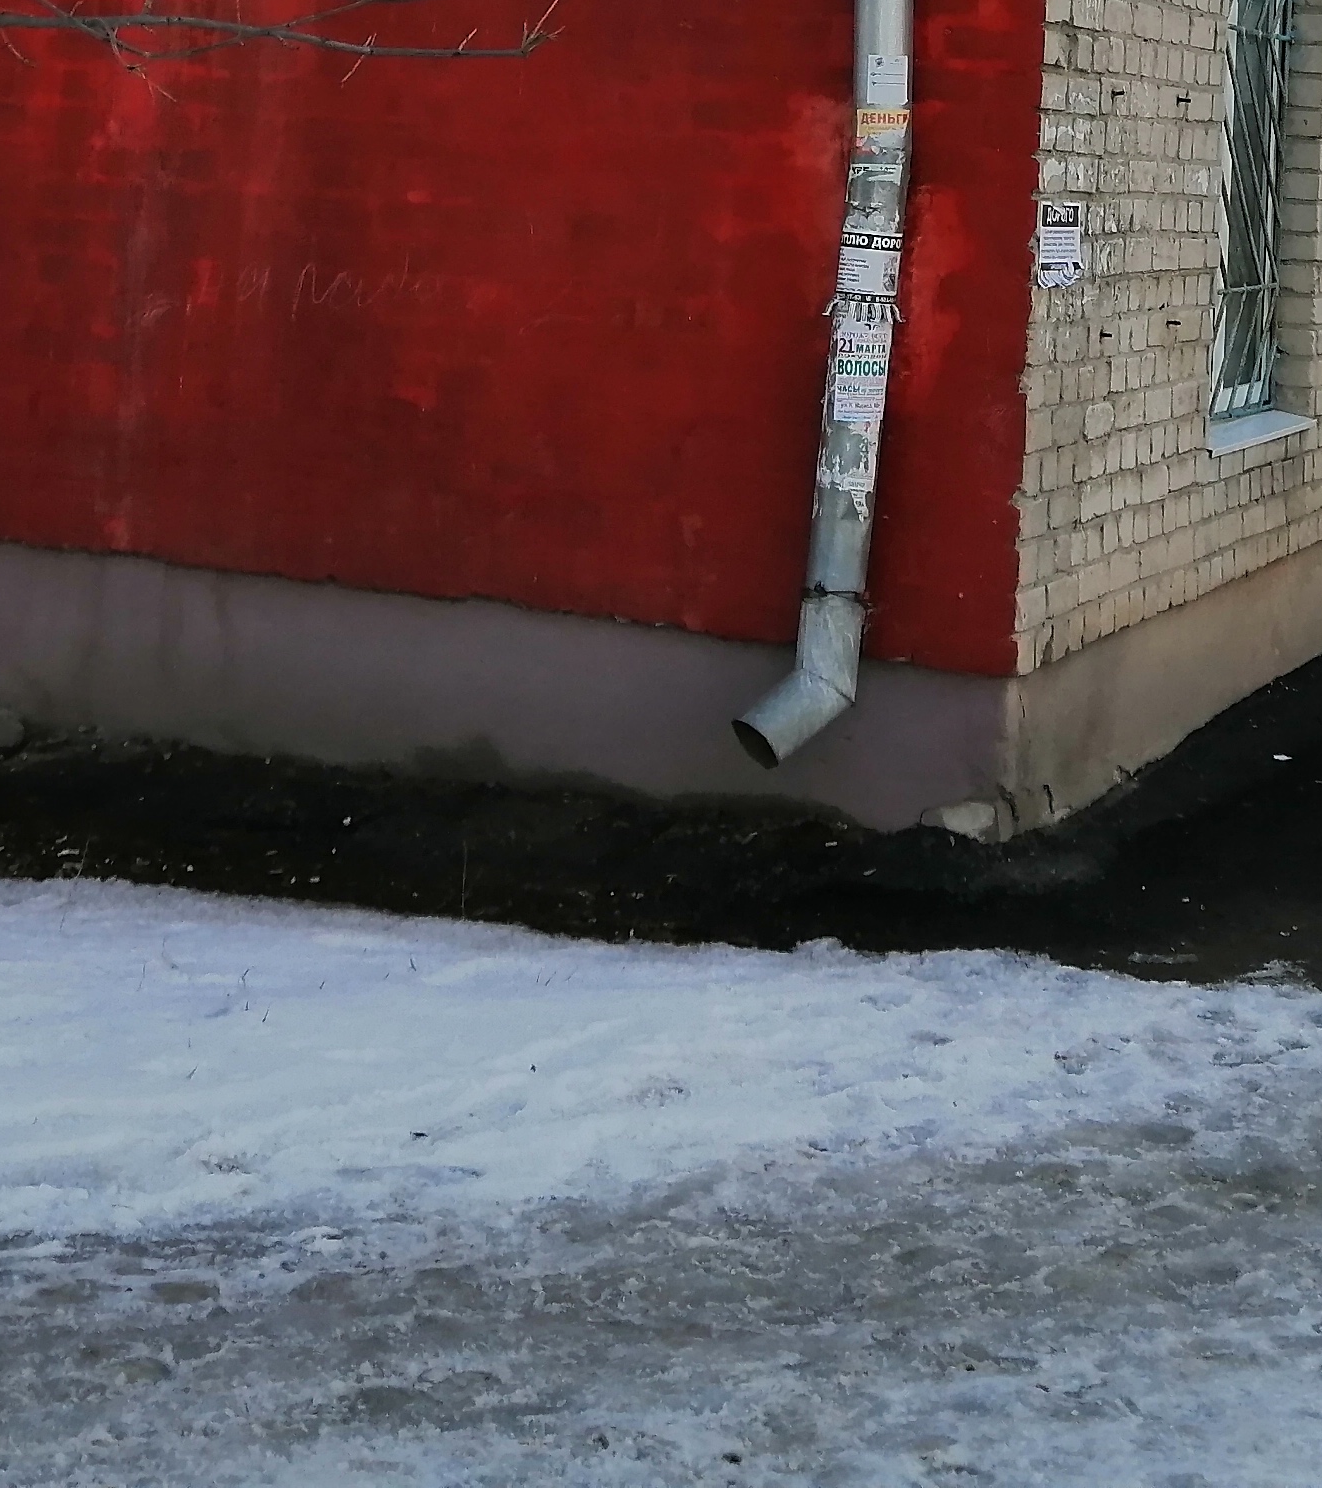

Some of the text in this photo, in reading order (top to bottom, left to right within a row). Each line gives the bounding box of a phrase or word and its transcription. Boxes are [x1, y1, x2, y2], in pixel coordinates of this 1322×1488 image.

[841, 233, 903, 249] ПЛЮ ДОРО
[839, 338, 855, 353] 21
[837, 359, 886, 376] ВОЛОСЫ
